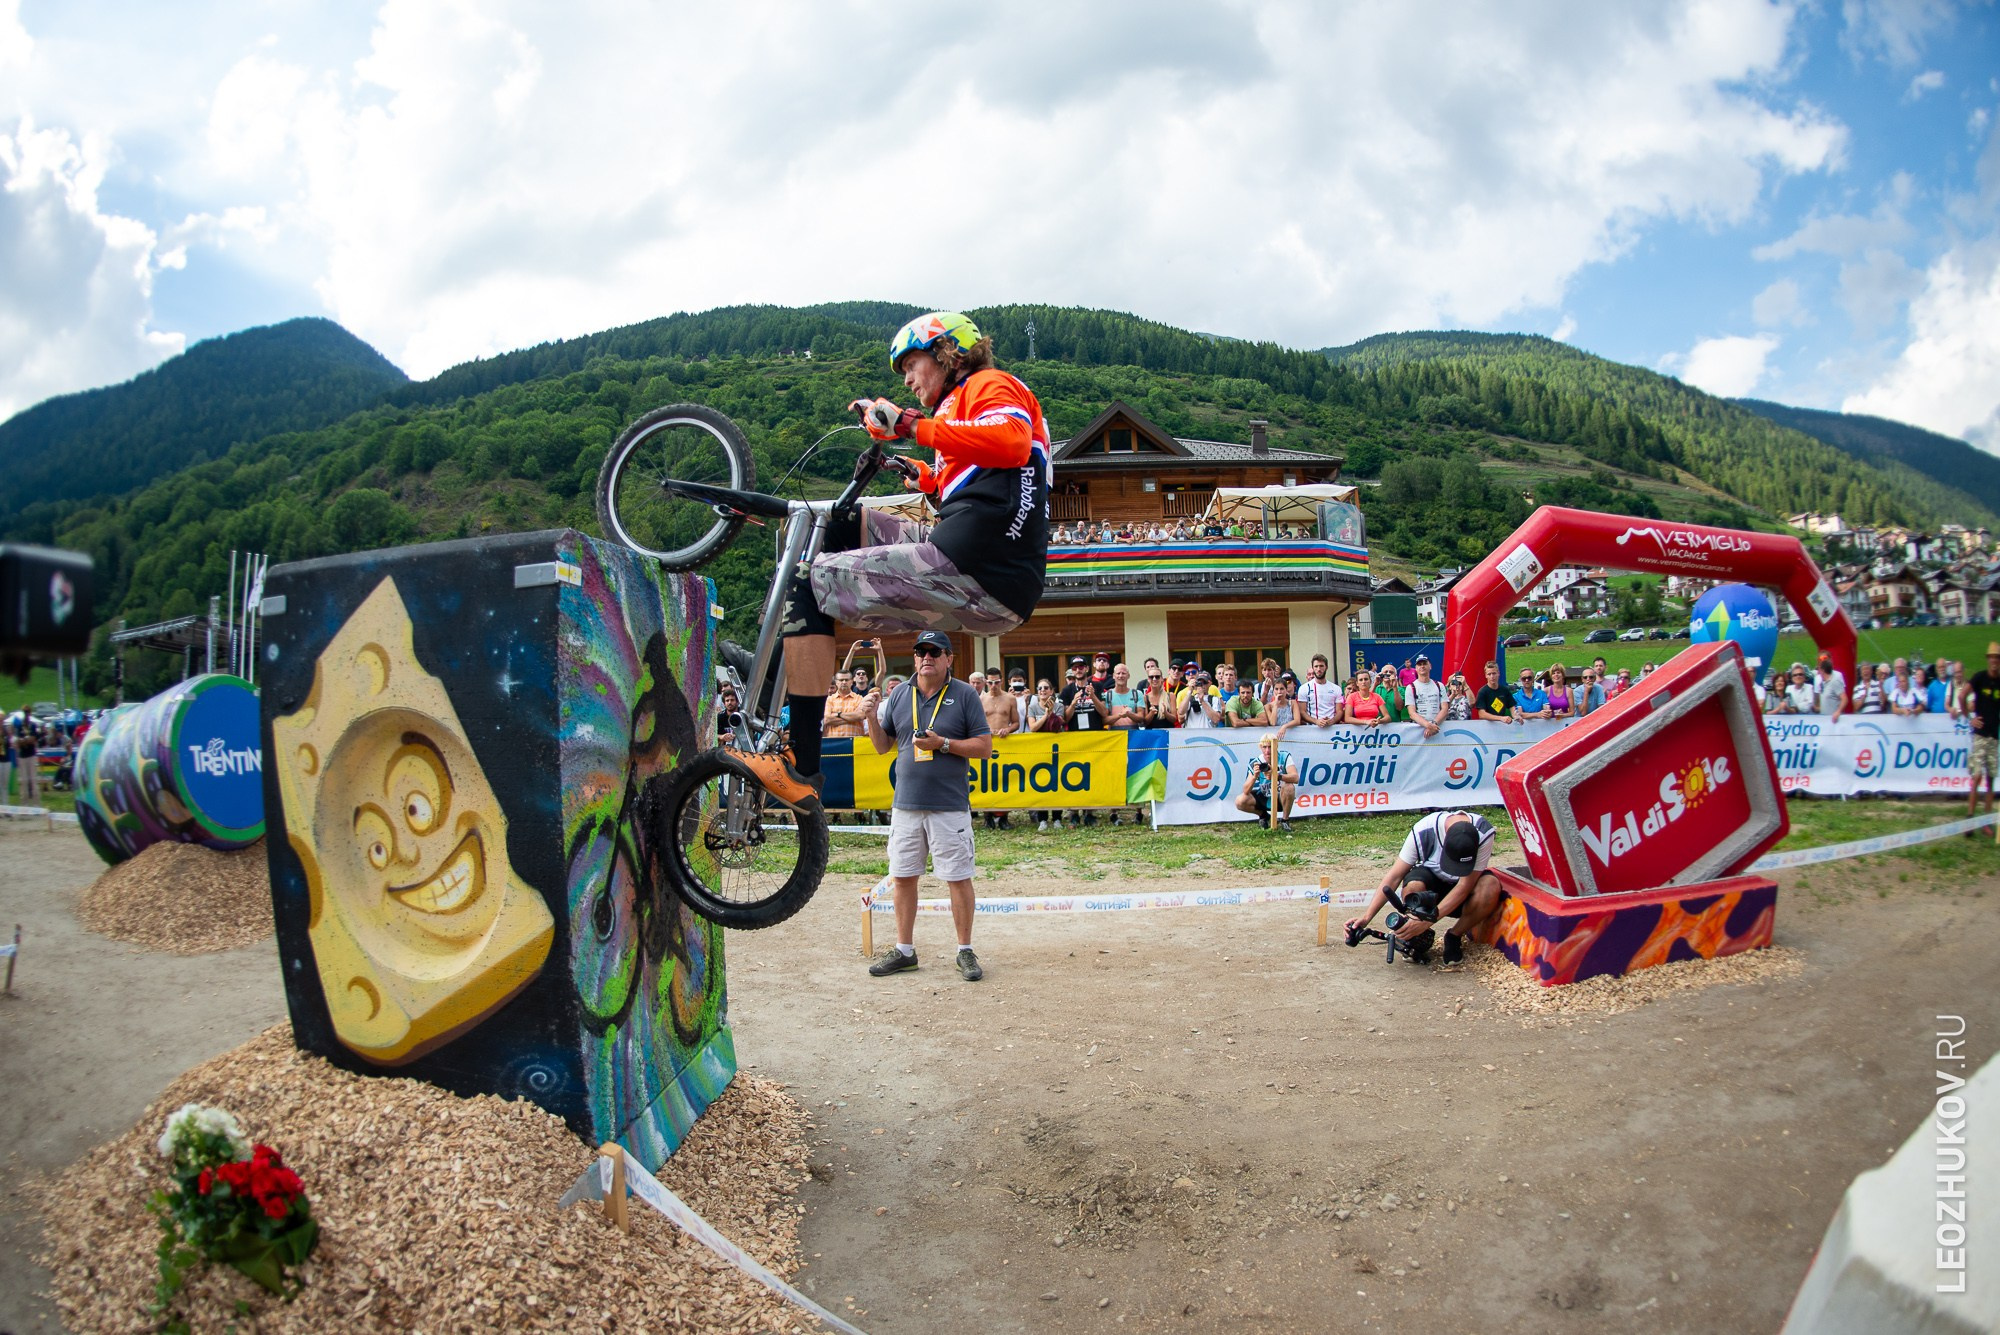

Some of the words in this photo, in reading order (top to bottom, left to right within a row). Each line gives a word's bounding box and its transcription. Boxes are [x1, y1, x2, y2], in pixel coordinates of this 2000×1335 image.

[1005, 466, 1037, 540] Rabobank
[1656, 529, 1751, 552] VERMIGLIO
[1637, 556, 1733, 573] www.vermigliovacanze.it
[1667, 548, 1709, 561] VACANZE
[1355, 650, 1365, 670] CON
[1331, 729, 1401, 754] Hydro
[1767, 719, 1820, 742] Hydro
[189, 745, 262, 776] TRENTIN
[1297, 754, 1398, 787] lomiti
[1295, 788, 1389, 809] energia
